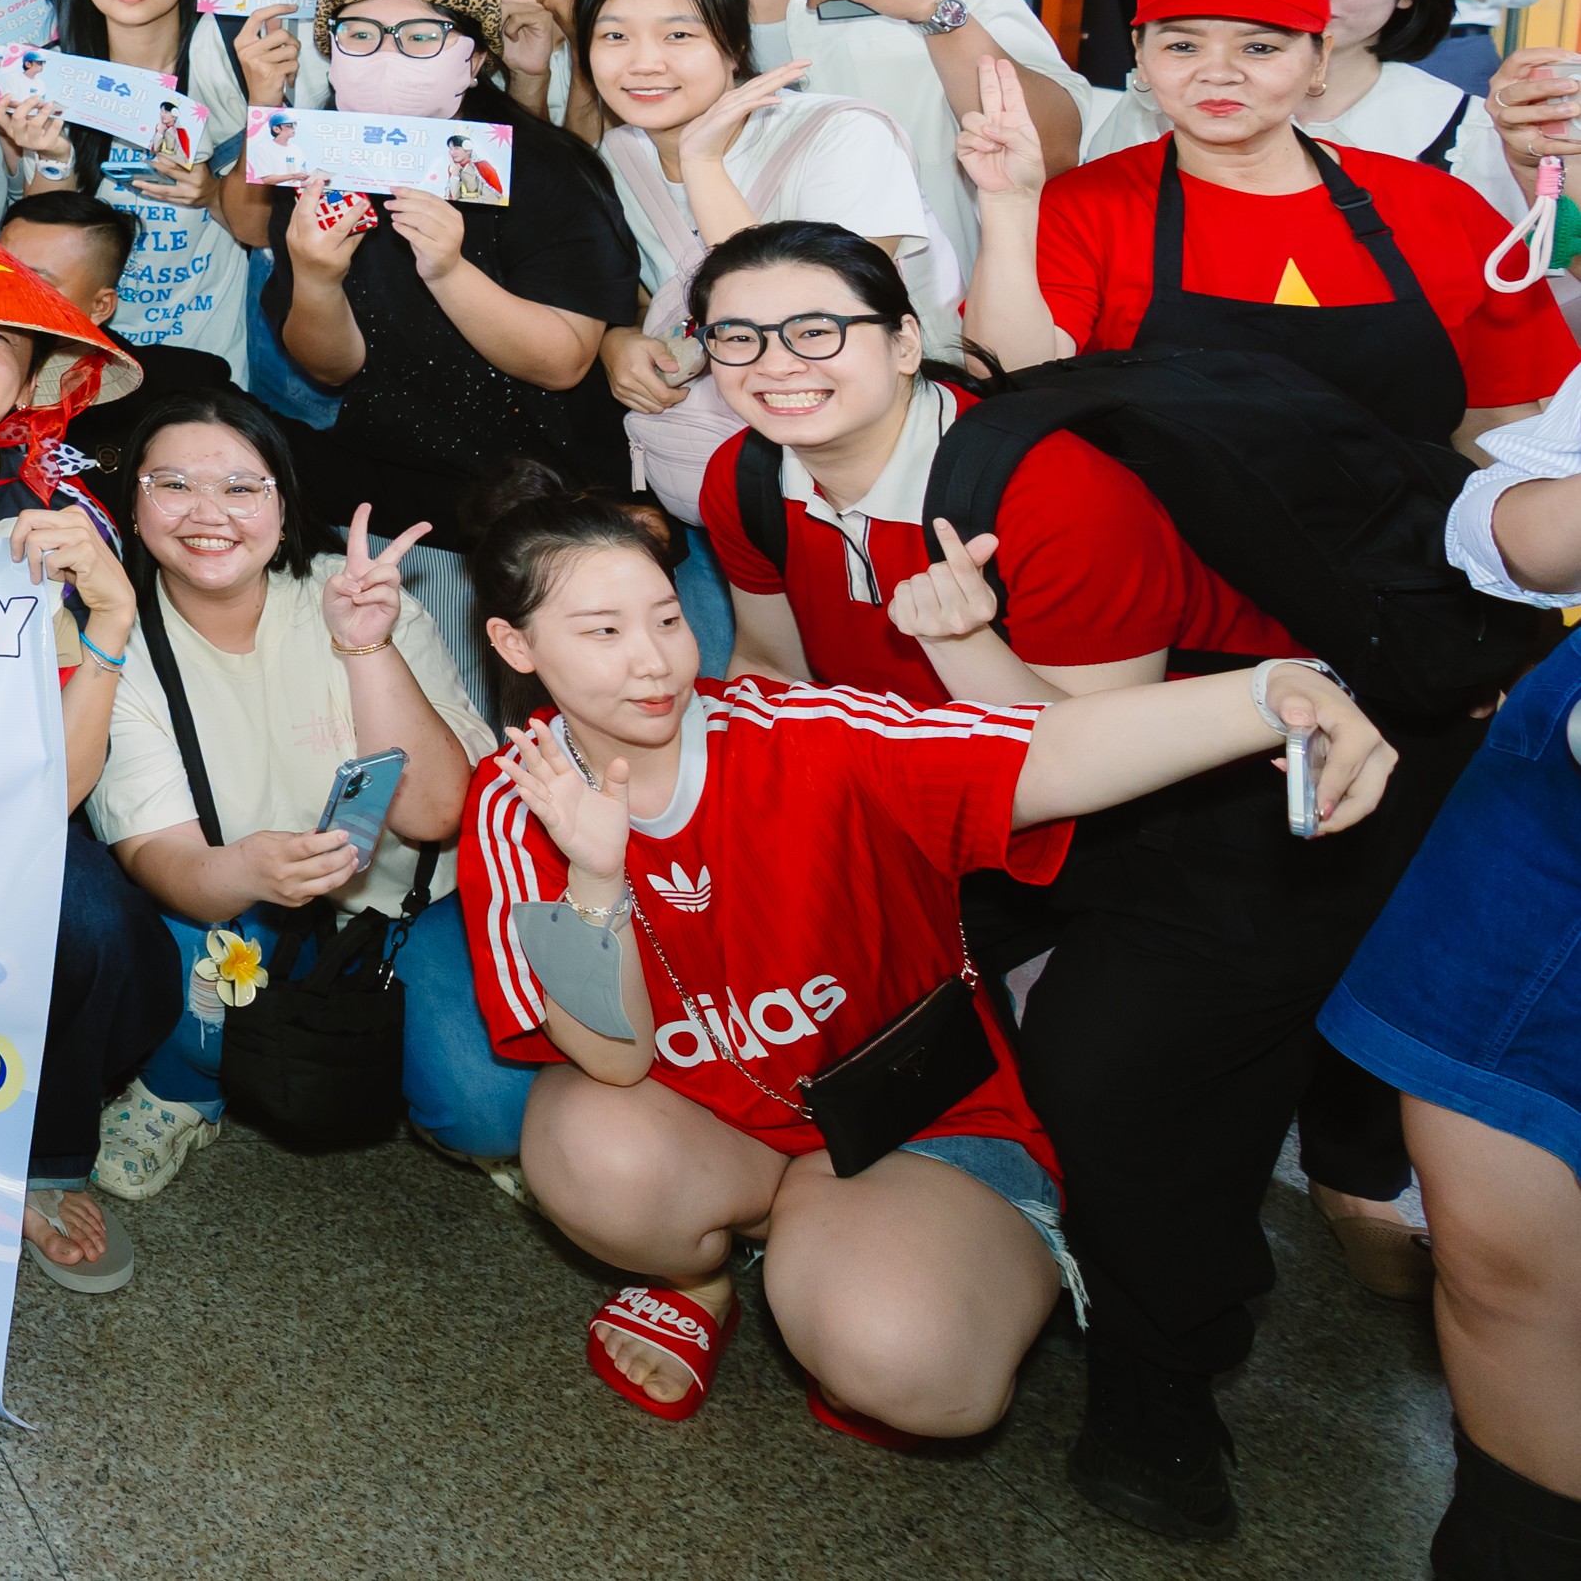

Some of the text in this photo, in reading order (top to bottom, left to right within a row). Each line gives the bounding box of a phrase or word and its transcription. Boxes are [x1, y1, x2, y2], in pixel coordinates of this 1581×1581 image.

[58, 65, 149, 105] 우리 광수가
[60, 84, 141, 120] 또 왔어요!
[314, 123, 429, 148] 우리 광수가
[323, 147, 425, 172] 또 왔어요!
[653, 974, 847, 1068] didas
